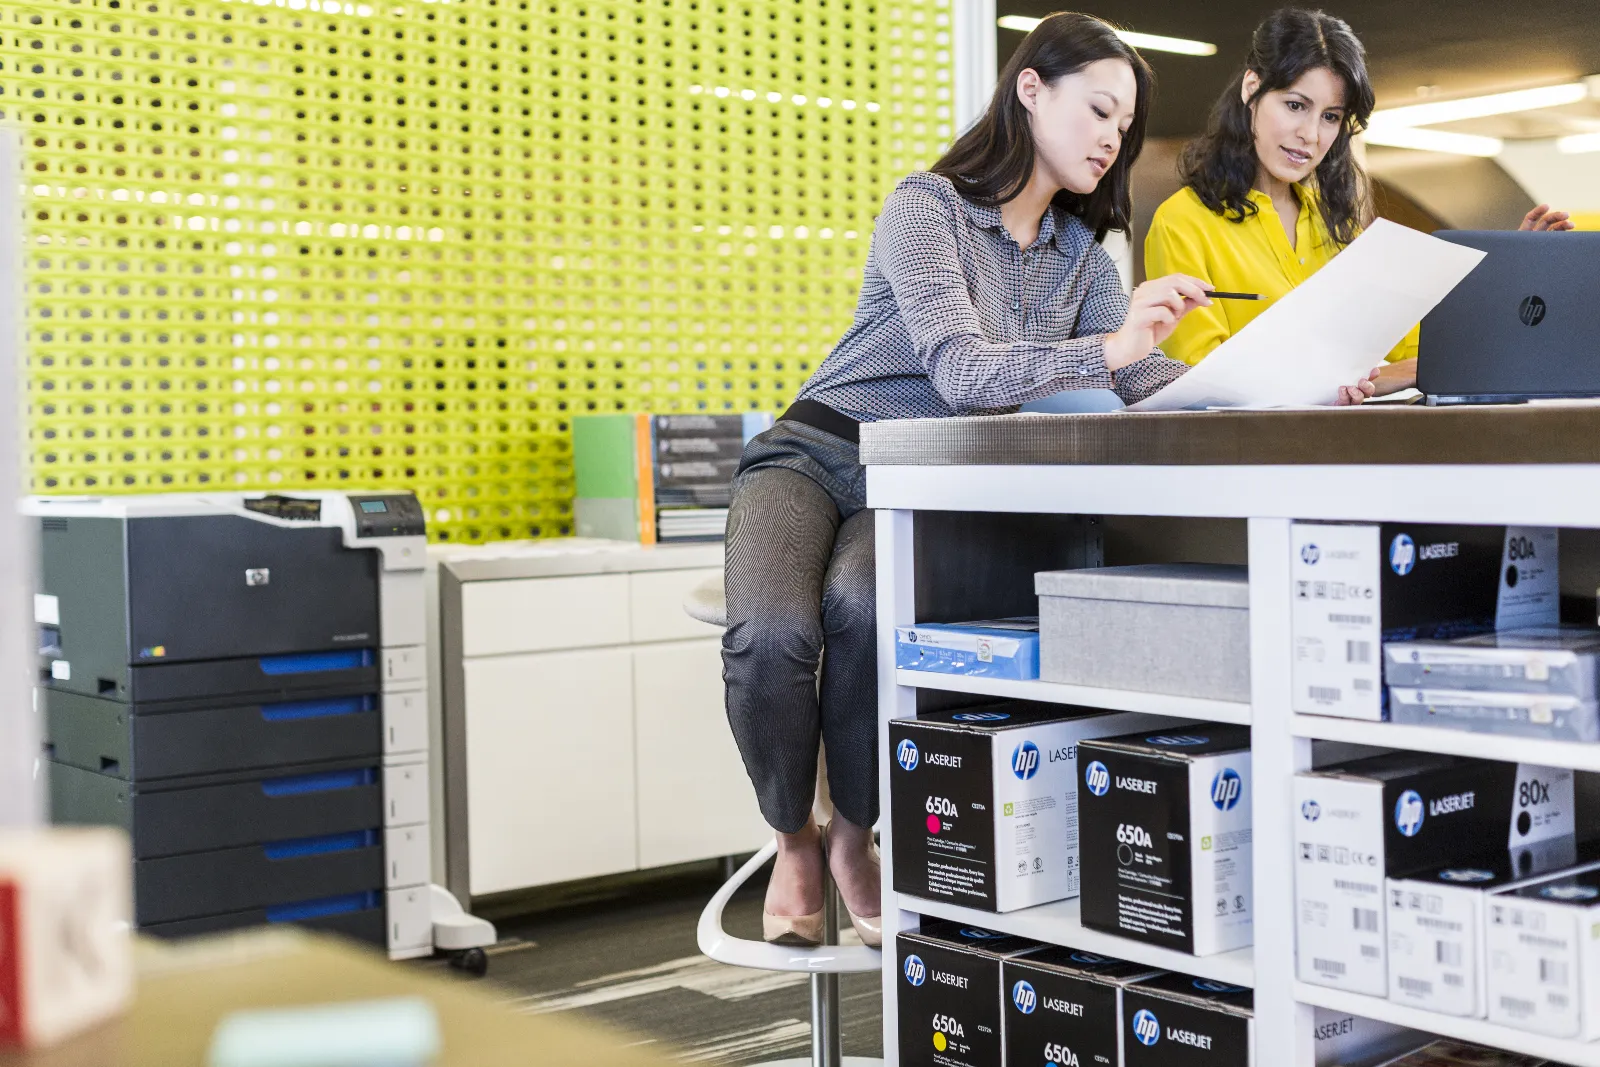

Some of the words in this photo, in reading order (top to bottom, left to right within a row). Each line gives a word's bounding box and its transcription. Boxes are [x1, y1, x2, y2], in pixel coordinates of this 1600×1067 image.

[1519, 295, 1546, 327] hp
[1389, 532, 1416, 576] hp
[1419, 542, 1459, 561] LASERJET
[1508, 535, 1537, 562] 80A
[896, 738, 919, 771] hp
[924, 752, 962, 768] LASERJET
[1011, 740, 1040, 780] hp
[1085, 760, 1110, 796] hp
[1115, 776, 1157, 795] LASERJET
[1210, 767, 1242, 812] hp
[925, 795, 959, 818] 650A
[1395, 789, 1425, 837] hp
[1429, 791, 1475, 817] LASERJET
[1116, 823, 1153, 849] 650A
[904, 954, 926, 987] hp
[931, 969, 969, 990] LASERJET
[1013, 980, 1037, 1014] hp
[1043, 996, 1084, 1017] LASERJET
[932, 1013, 965, 1038] 650A
[1133, 1009, 1160, 1046] hp
[1166, 1026, 1212, 1050] LASERJET
[1044, 1042, 1080, 1067] 650A
